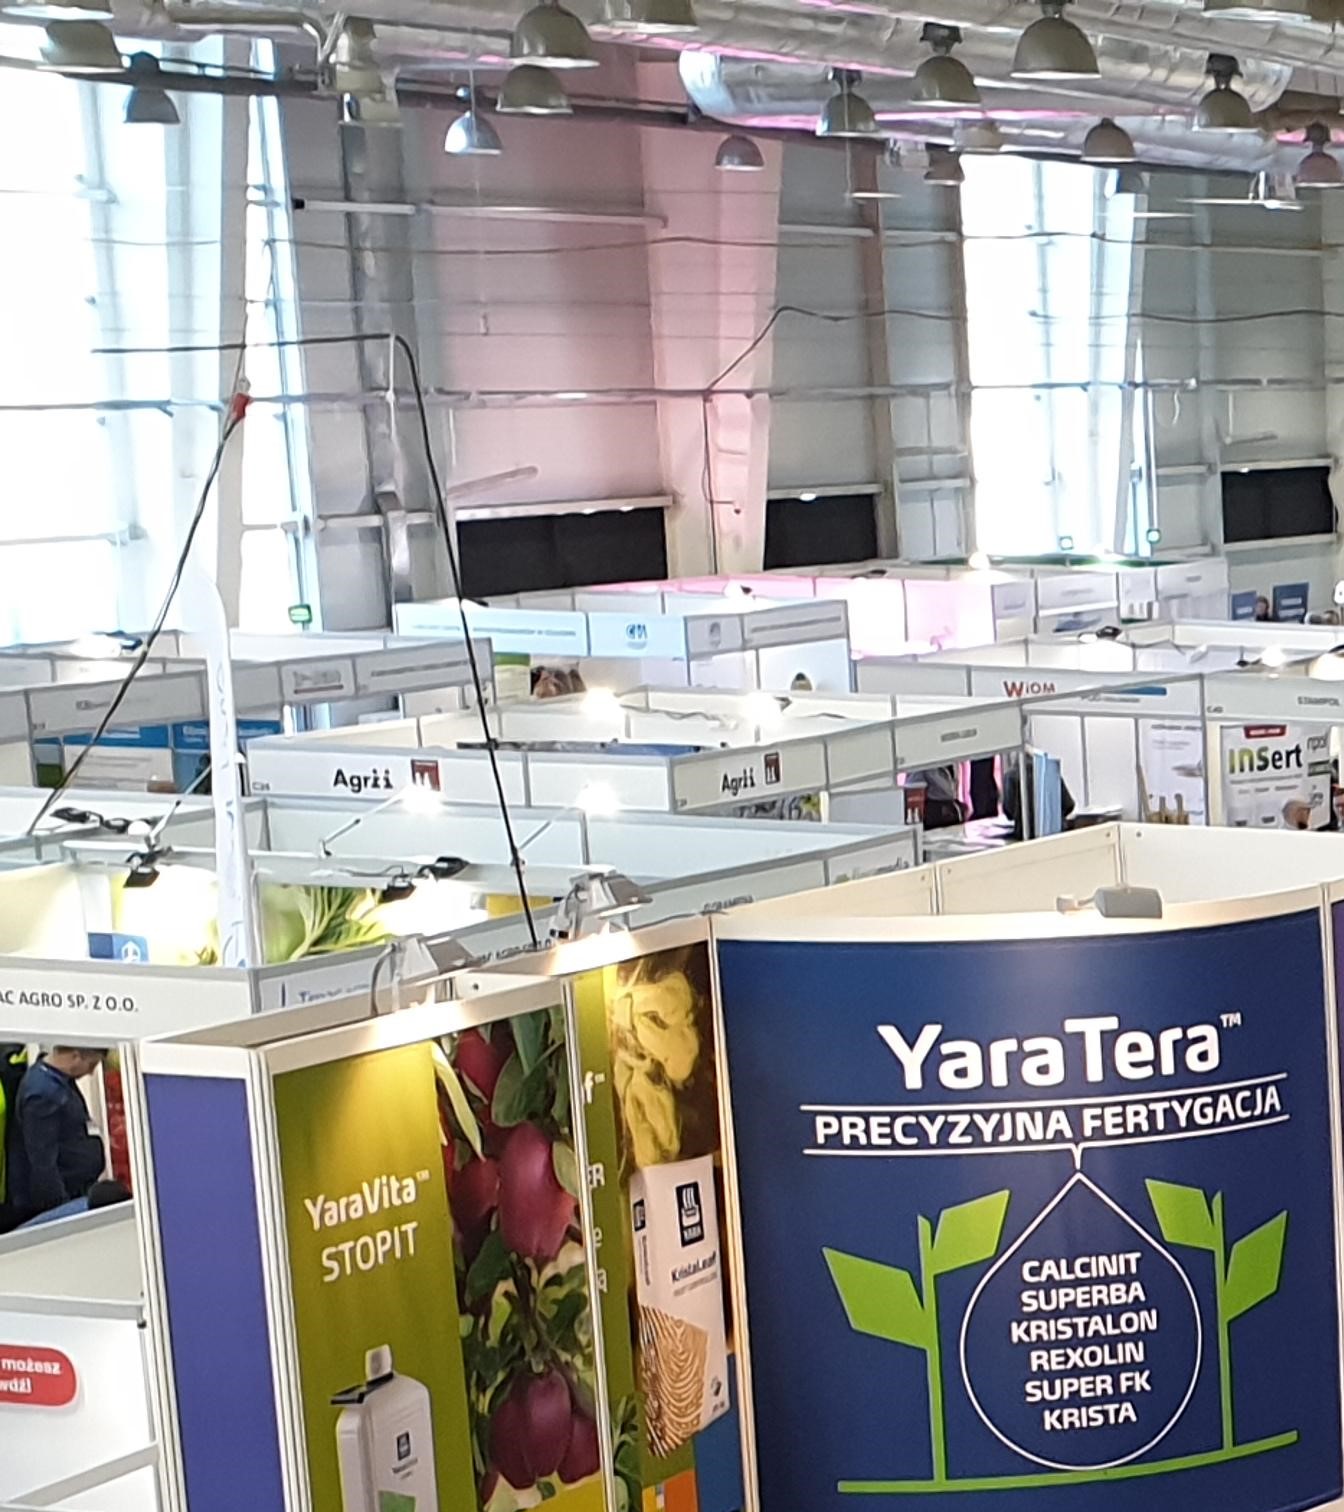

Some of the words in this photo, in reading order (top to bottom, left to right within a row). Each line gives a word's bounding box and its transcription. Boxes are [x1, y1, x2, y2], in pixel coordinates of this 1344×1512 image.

[333, 768, 393, 794] Agrii
[722, 766, 756, 796] Agrii
[19, 991, 63, 1008] AGRO
[67, 994, 89, 1009] SP.
[814, 1108, 1073, 1147] PRECYZYJNA
[1082, 1086, 1282, 1137] FERTYGACJA
[321, 1222, 418, 1283] STOPIT
[1022, 1252, 1141, 1283] CALCINIT
[1020, 1281, 1146, 1311] SUPERBA
[1010, 1309, 1158, 1343] KRISTALON
[1029, 1341, 1145, 1372] REXOLIN
[1025, 1374, 1114, 1402] SUPER
[1120, 1370, 1150, 1395] FK
[1043, 1403, 1137, 1431] KRISTA
